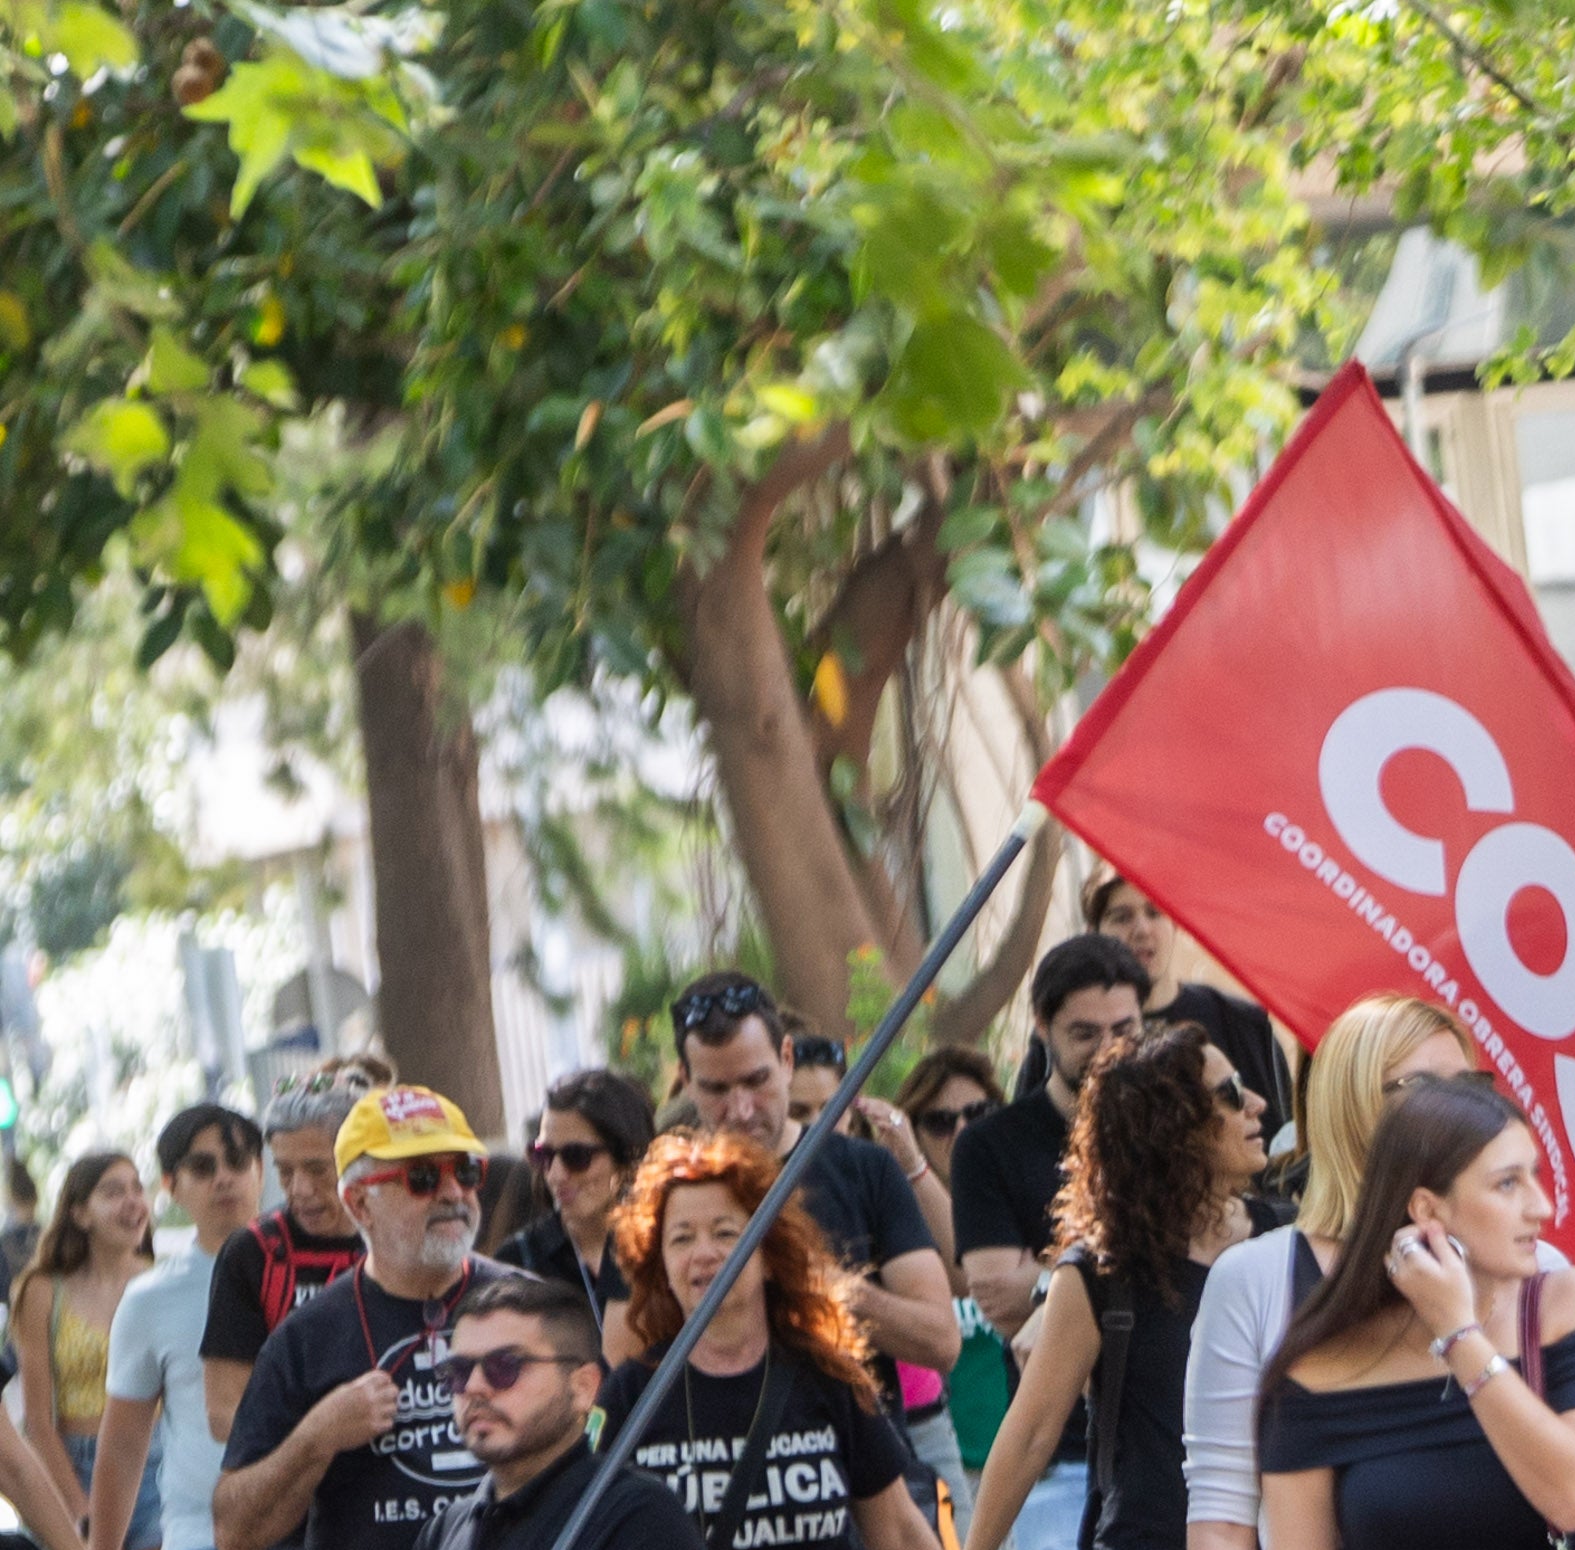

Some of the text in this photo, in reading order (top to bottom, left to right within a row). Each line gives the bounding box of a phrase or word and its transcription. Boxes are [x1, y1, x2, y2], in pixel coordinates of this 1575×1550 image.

[1263, 811, 1460, 1006] COORDINADORA
[1457, 999, 1534, 1110] OBRERA
[680, 1437, 730, 1462] UNA
[705, 1506, 848, 1550] UALITAT
